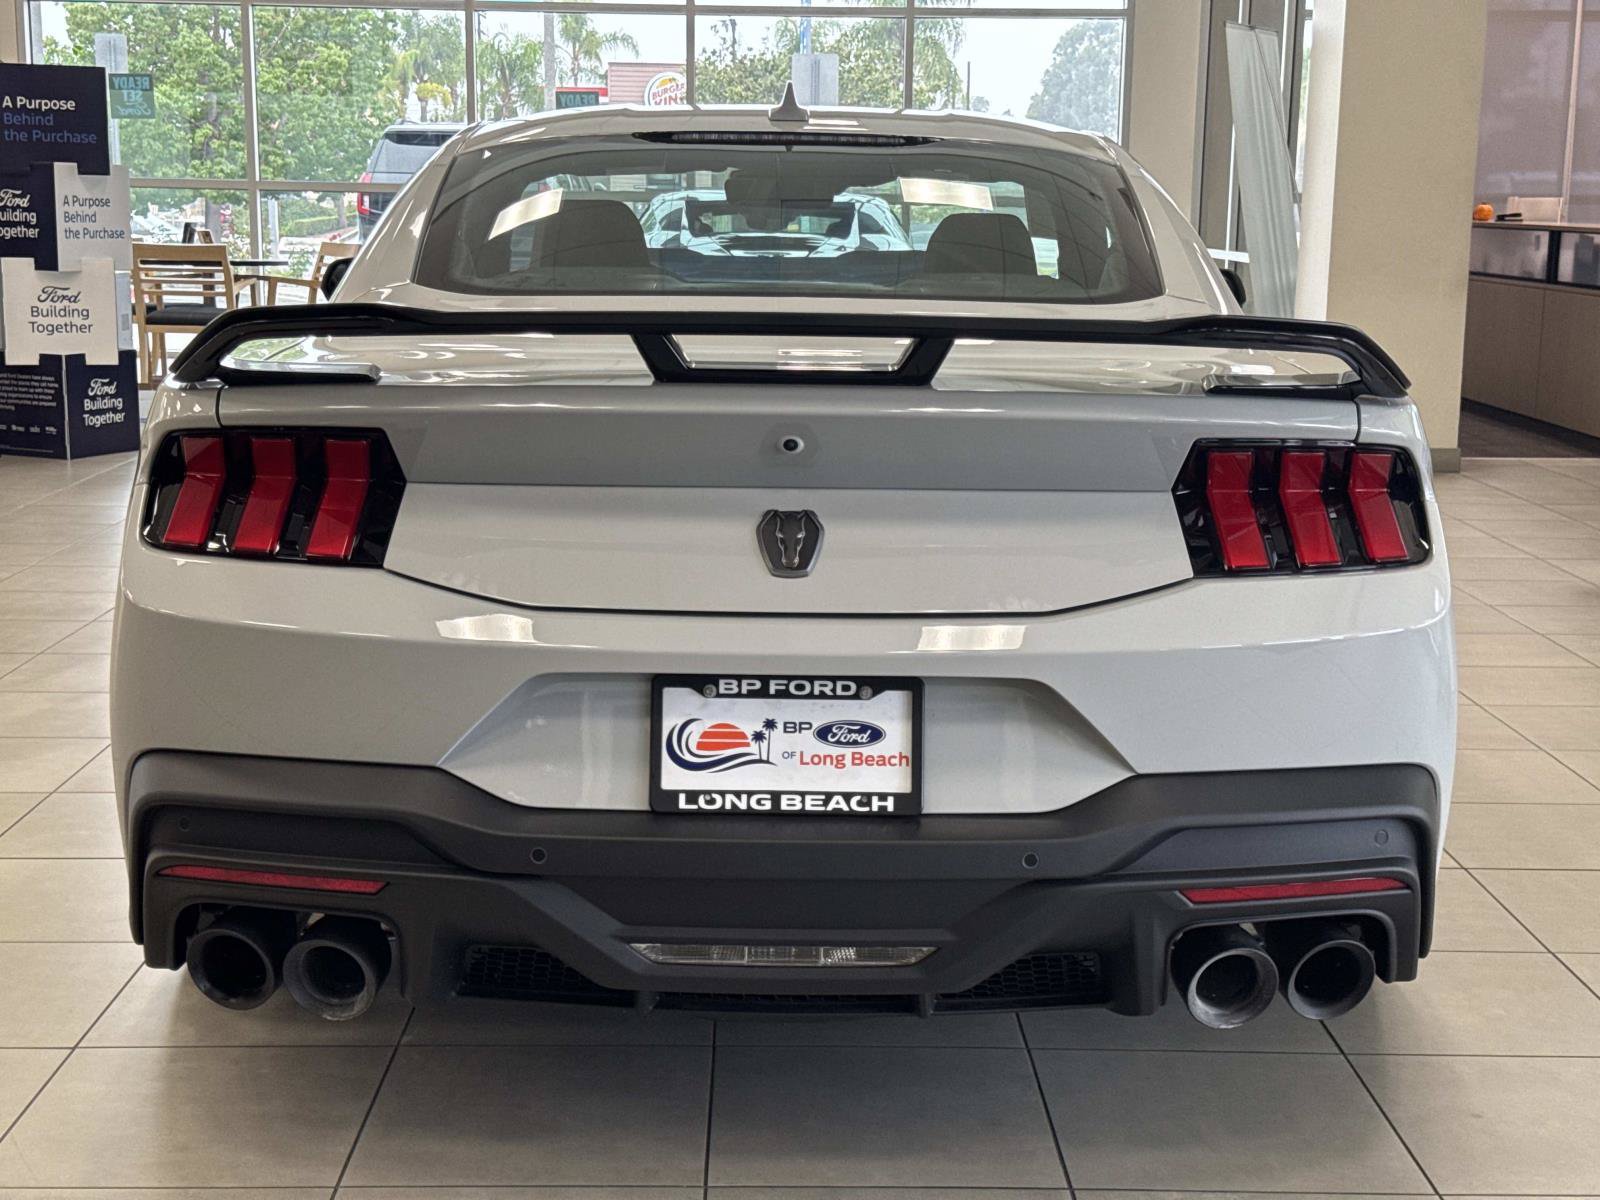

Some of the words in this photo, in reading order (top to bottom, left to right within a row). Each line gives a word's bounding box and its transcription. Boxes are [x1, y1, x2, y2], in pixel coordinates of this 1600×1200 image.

[3, 96, 13, 109] A
[17, 96, 76, 112] Purpose
[3, 112, 54, 126] Behind
[4, 129, 28, 142] the
[33, 130, 97, 144] Purchase
[0, 188, 31, 208] Ford
[63, 195, 71, 207] A
[72, 195, 111, 209] Purpose
[0, 208, 37, 225] uilding
[64, 211, 97, 224] Behind
[0, 225, 40, 240] ogether
[64, 227, 81, 240] the
[83, 227, 125, 240] Purchase
[37, 285, 81, 304] Ford
[30, 305, 90, 320] Building
[28, 321, 94, 336] Together
[88, 378, 117, 396] Ford
[84, 397, 123, 411] Building
[82, 411, 126, 428] Together
[718, 679, 762, 695] BP
[769, 680, 857, 696] FORD
[783, 721, 813, 734] BP
[827, 724, 871, 743] Ford
[782, 751, 797, 760] OF
[800, 751, 846, 769] Long
[851, 752, 910, 768] Beach
[678, 793, 771, 811] LONG
[780, 794, 895, 812] BEACH
